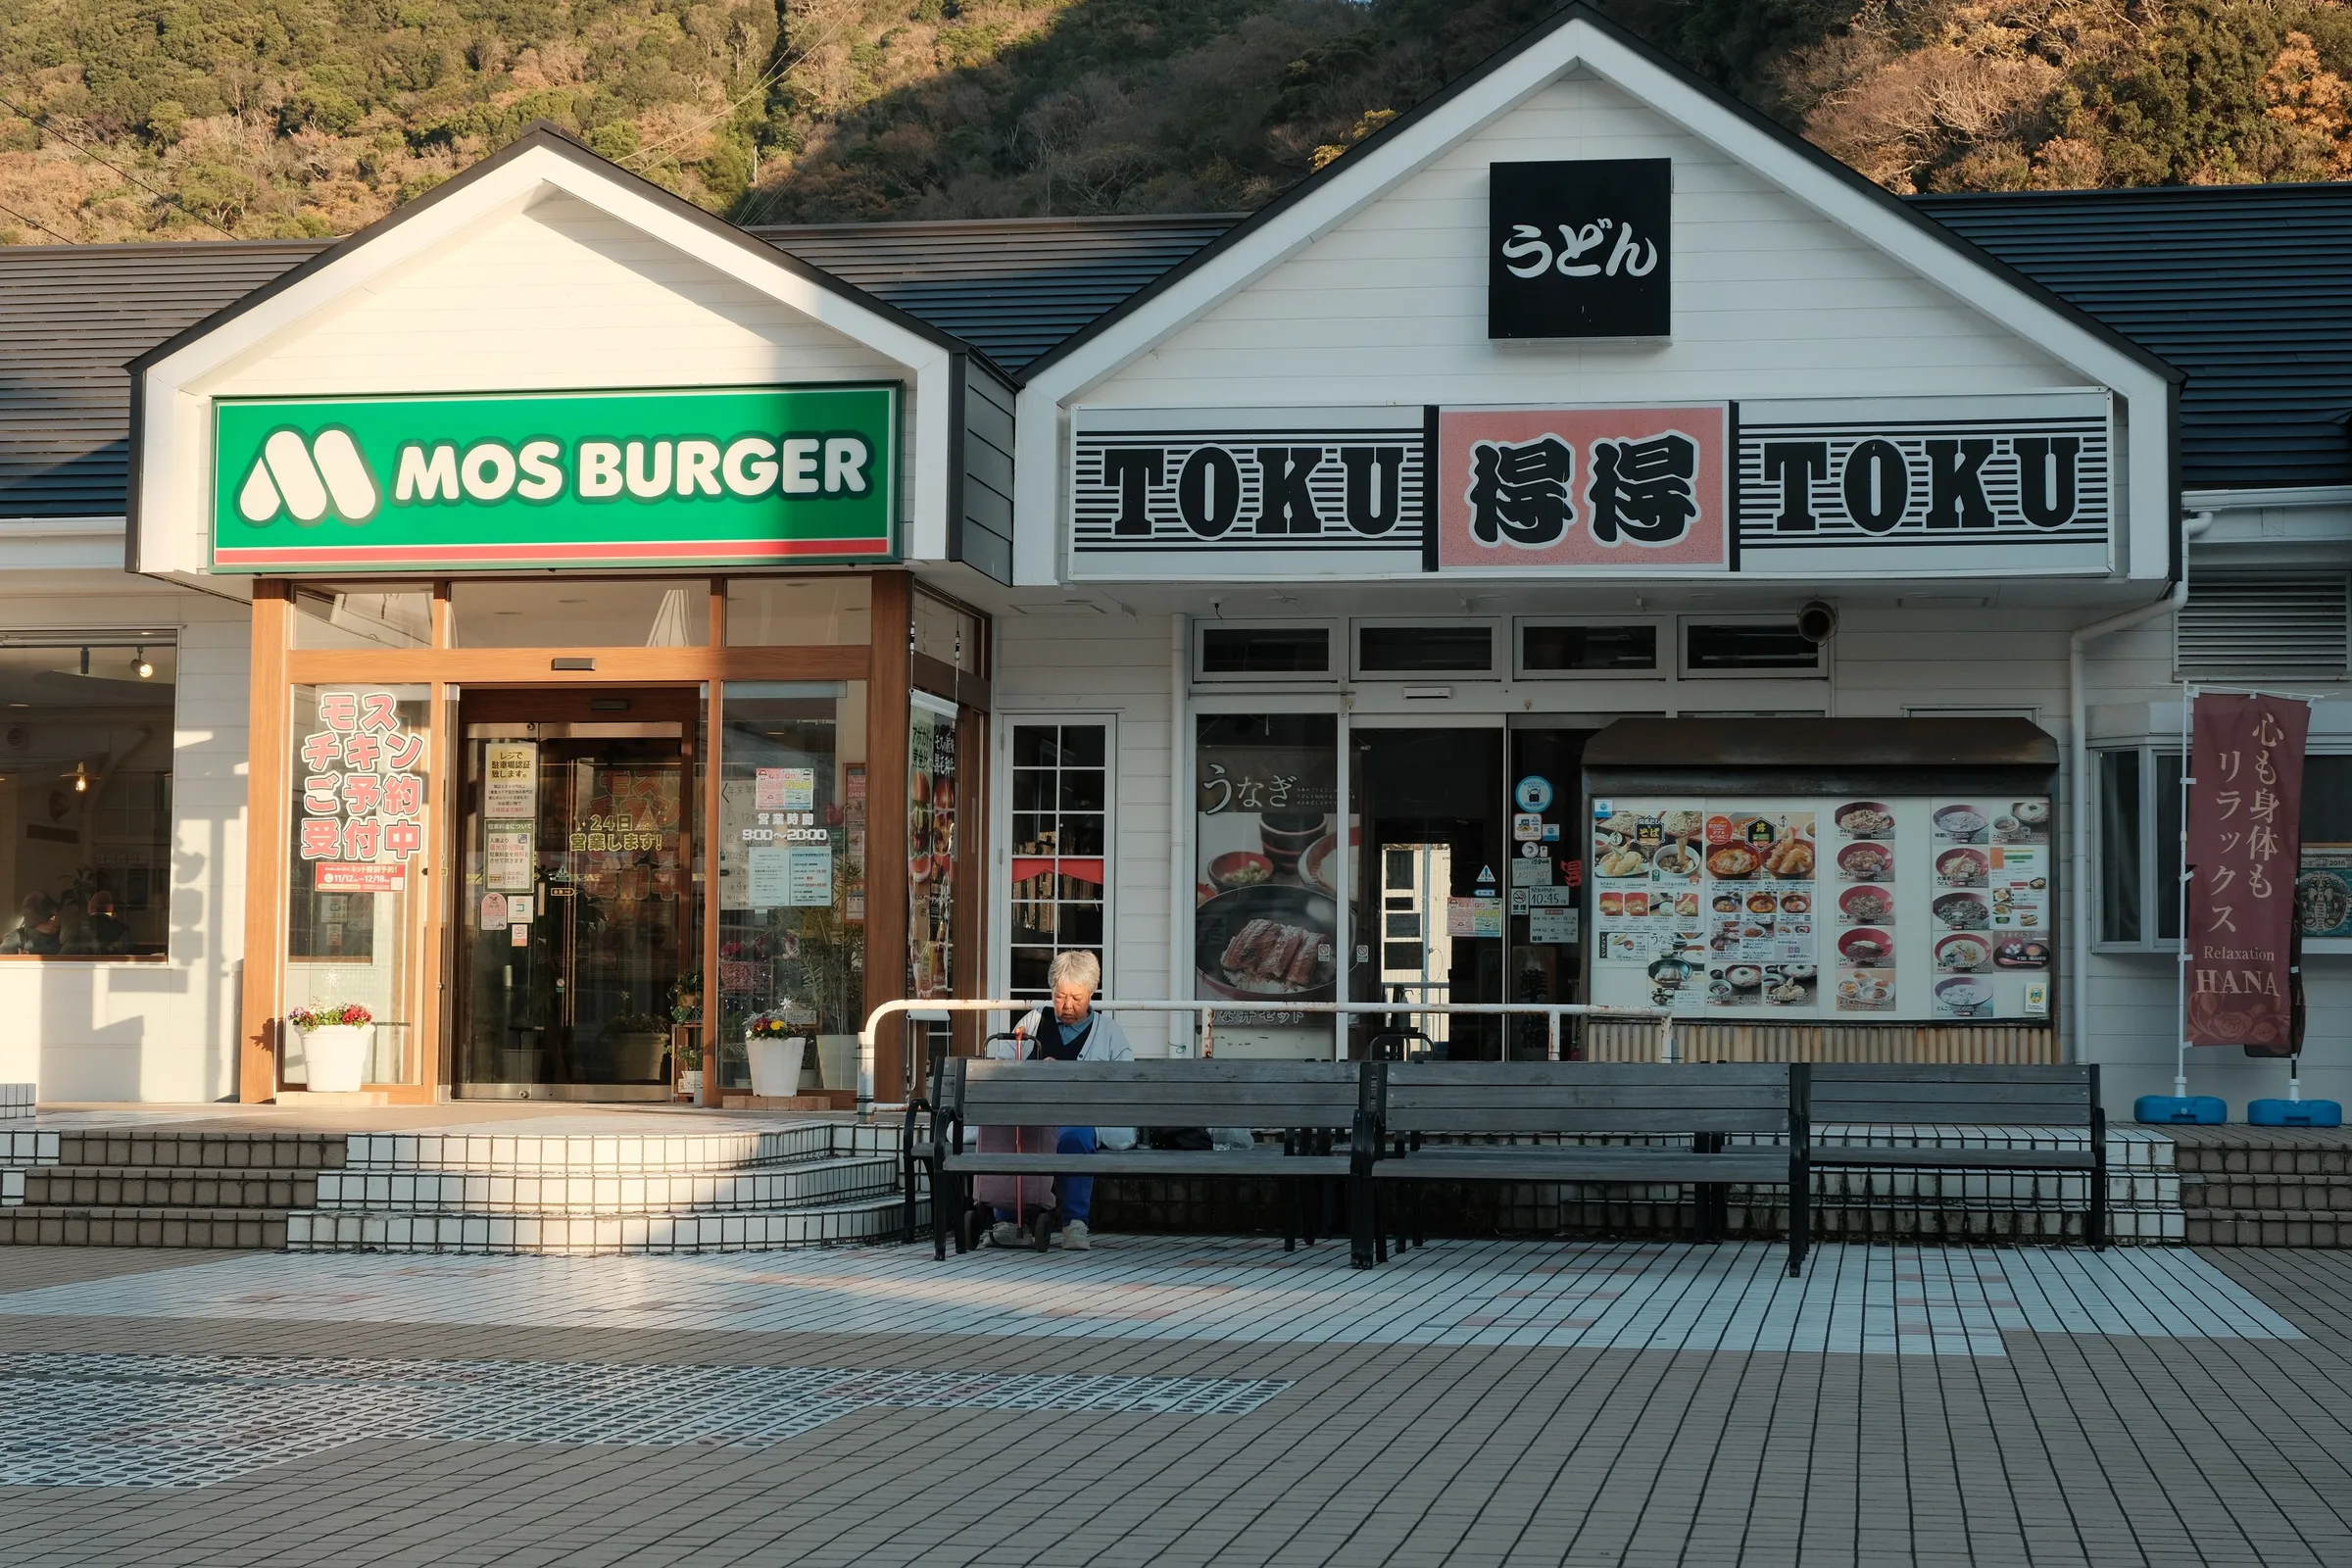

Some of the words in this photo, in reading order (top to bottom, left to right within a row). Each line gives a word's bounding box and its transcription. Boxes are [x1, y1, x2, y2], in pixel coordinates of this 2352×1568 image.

[1502, 218, 1658, 280] うどん
[394, 440, 564, 501] MOS
[578, 436, 867, 498] BURGER
[1765, 435, 2082, 535] TOKU
[1103, 444, 1405, 539] TOKU
[1467, 429, 1701, 549] 得得
[320, 692, 397, 732] モス
[301, 732, 423, 771] チキン
[492, 760, 530, 769] 駐車場認証
[301, 772, 423, 816] ご予約
[1203, 763, 1298, 814] うなぎ
[2246, 712, 2284, 899] 心も身体も
[590, 813, 632, 831] 24日
[758, 812, 814, 825] 営業時間
[1639, 827, 1660, 838] そば
[301, 818, 422, 860] 受付中
[569, 834, 662, 851] 営業します!
[2207, 751, 2242, 933] リラックス
[1531, 894, 1560, 904] 10:45
[2203, 945, 2276, 961] Relaxation
[2195, 968, 2281, 998] HANA
[1211, 1010, 1304, 1024] な丼セット
